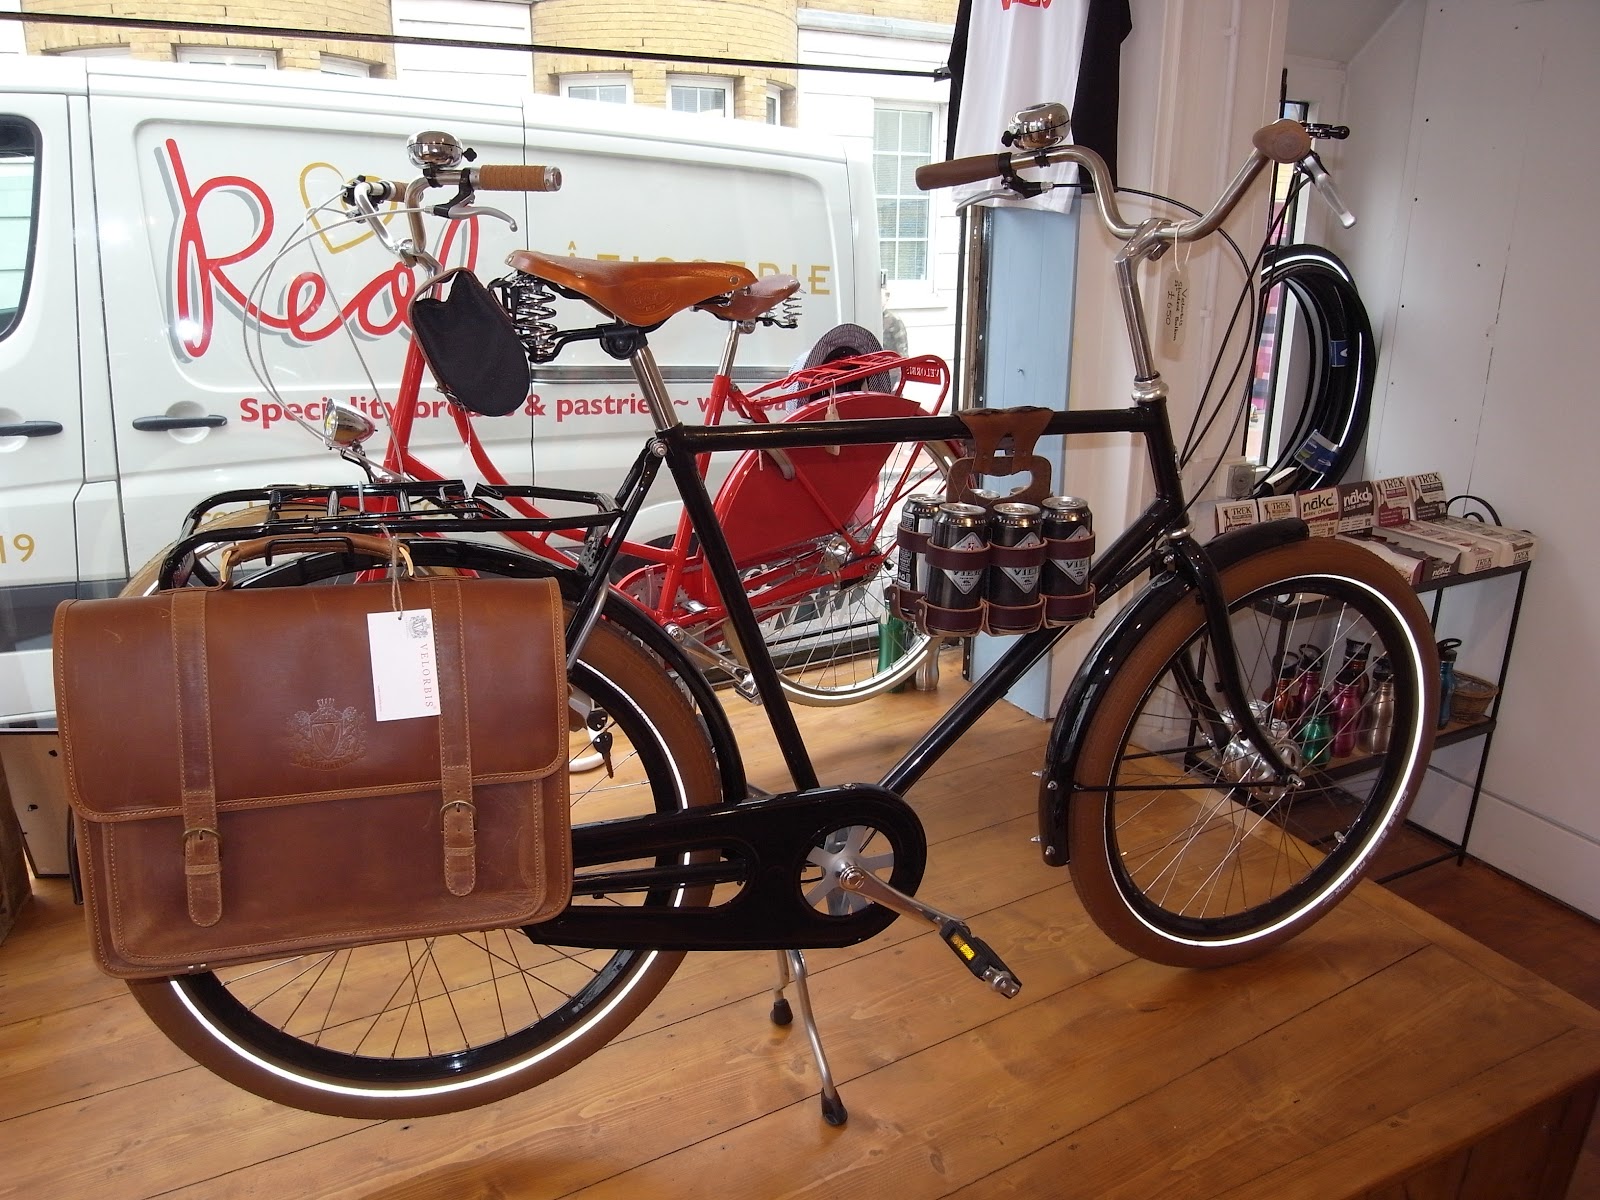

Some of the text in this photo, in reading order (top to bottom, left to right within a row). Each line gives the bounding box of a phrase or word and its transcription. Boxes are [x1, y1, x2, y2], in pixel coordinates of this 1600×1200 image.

[557, 393, 650, 423] pastrie
[1271, 501, 1291, 510] TREK
[1231, 506, 1252, 515] TREK
